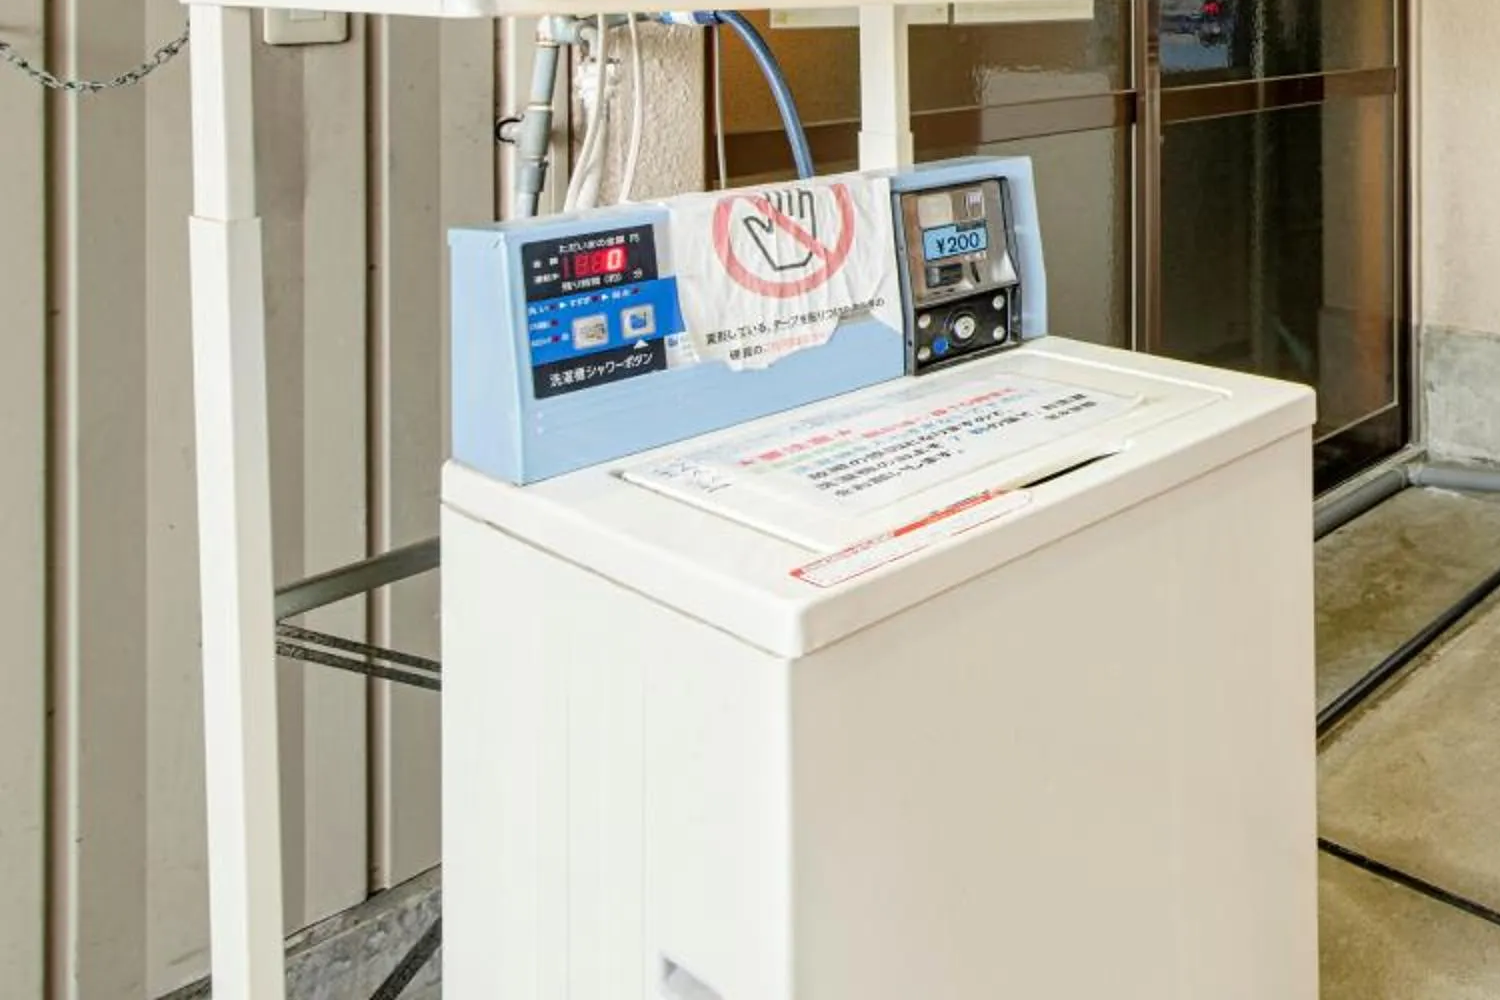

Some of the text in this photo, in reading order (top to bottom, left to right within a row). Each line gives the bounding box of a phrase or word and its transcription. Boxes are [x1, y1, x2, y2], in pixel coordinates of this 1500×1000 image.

[936, 231, 980, 254] ¥200
[550, 353, 653, 388] 洗濯機シャワーボタン
